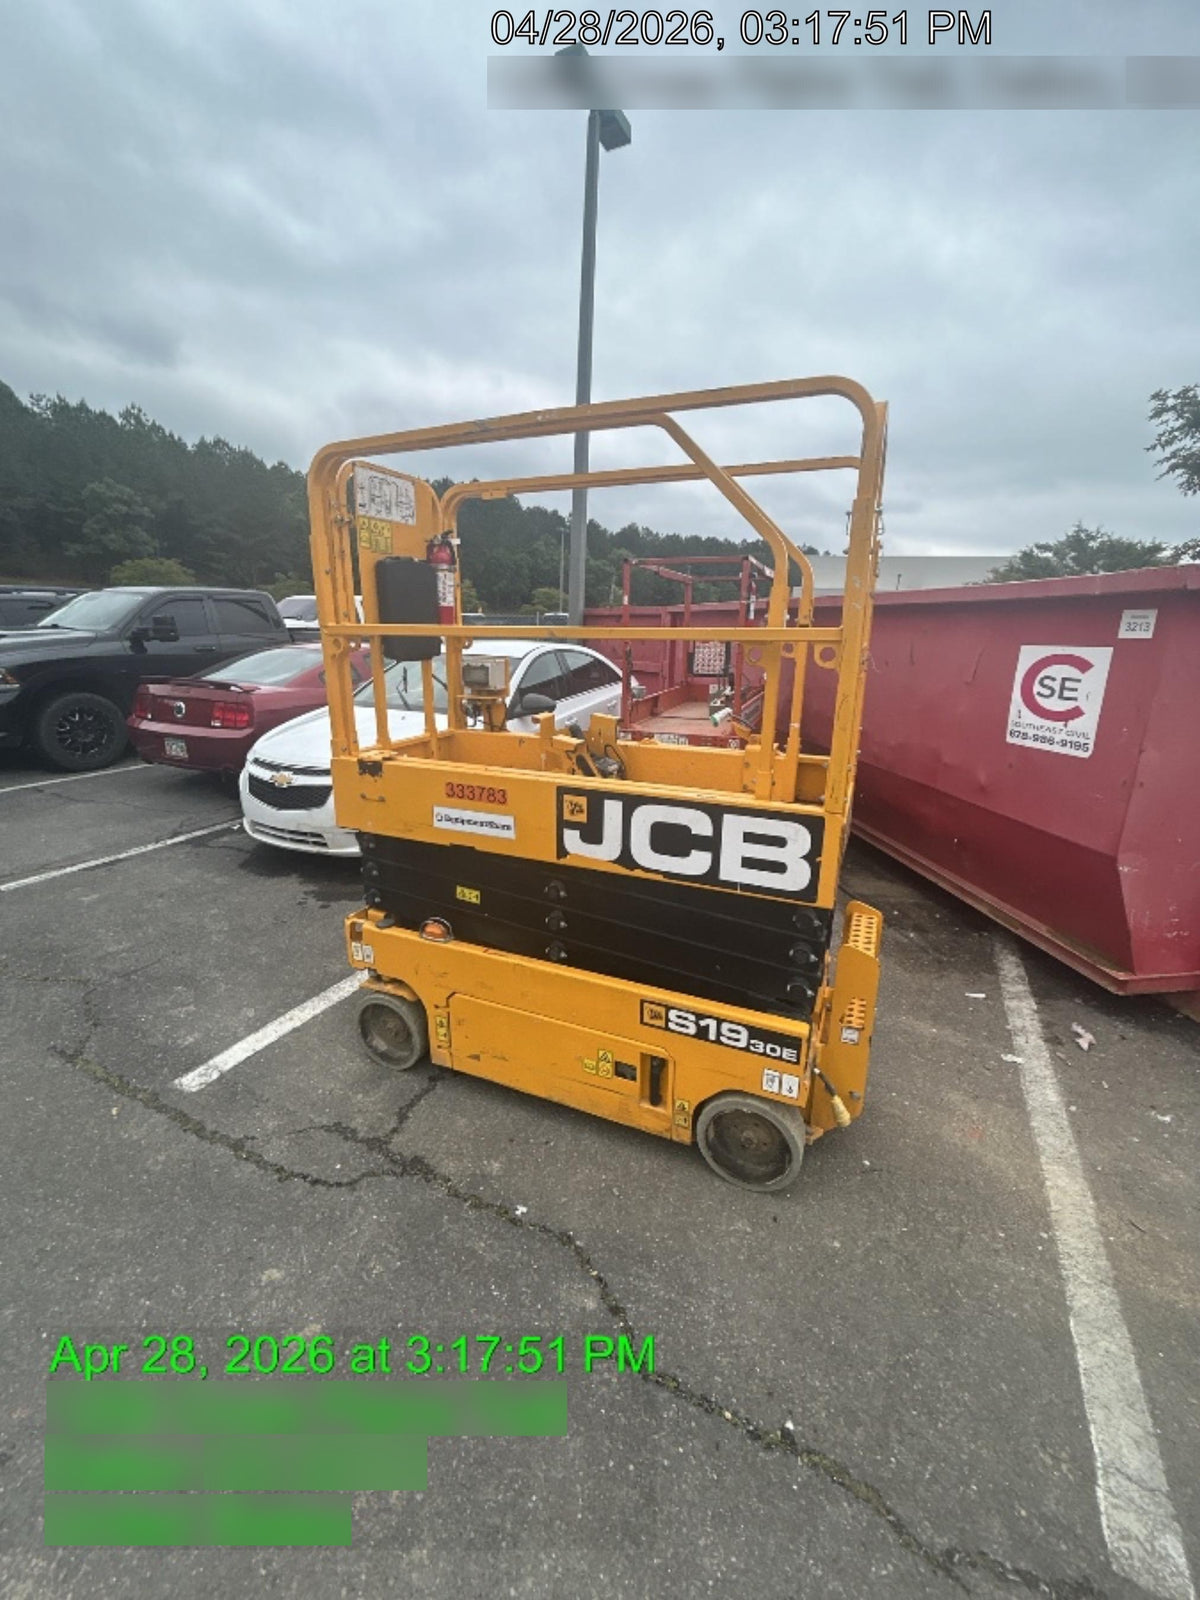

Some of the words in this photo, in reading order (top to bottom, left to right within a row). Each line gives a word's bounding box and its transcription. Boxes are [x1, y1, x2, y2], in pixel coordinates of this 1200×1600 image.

[1036, 675, 1082, 701] SE
[445, 782, 508, 805] 333783
[563, 799, 812, 892] JCB
